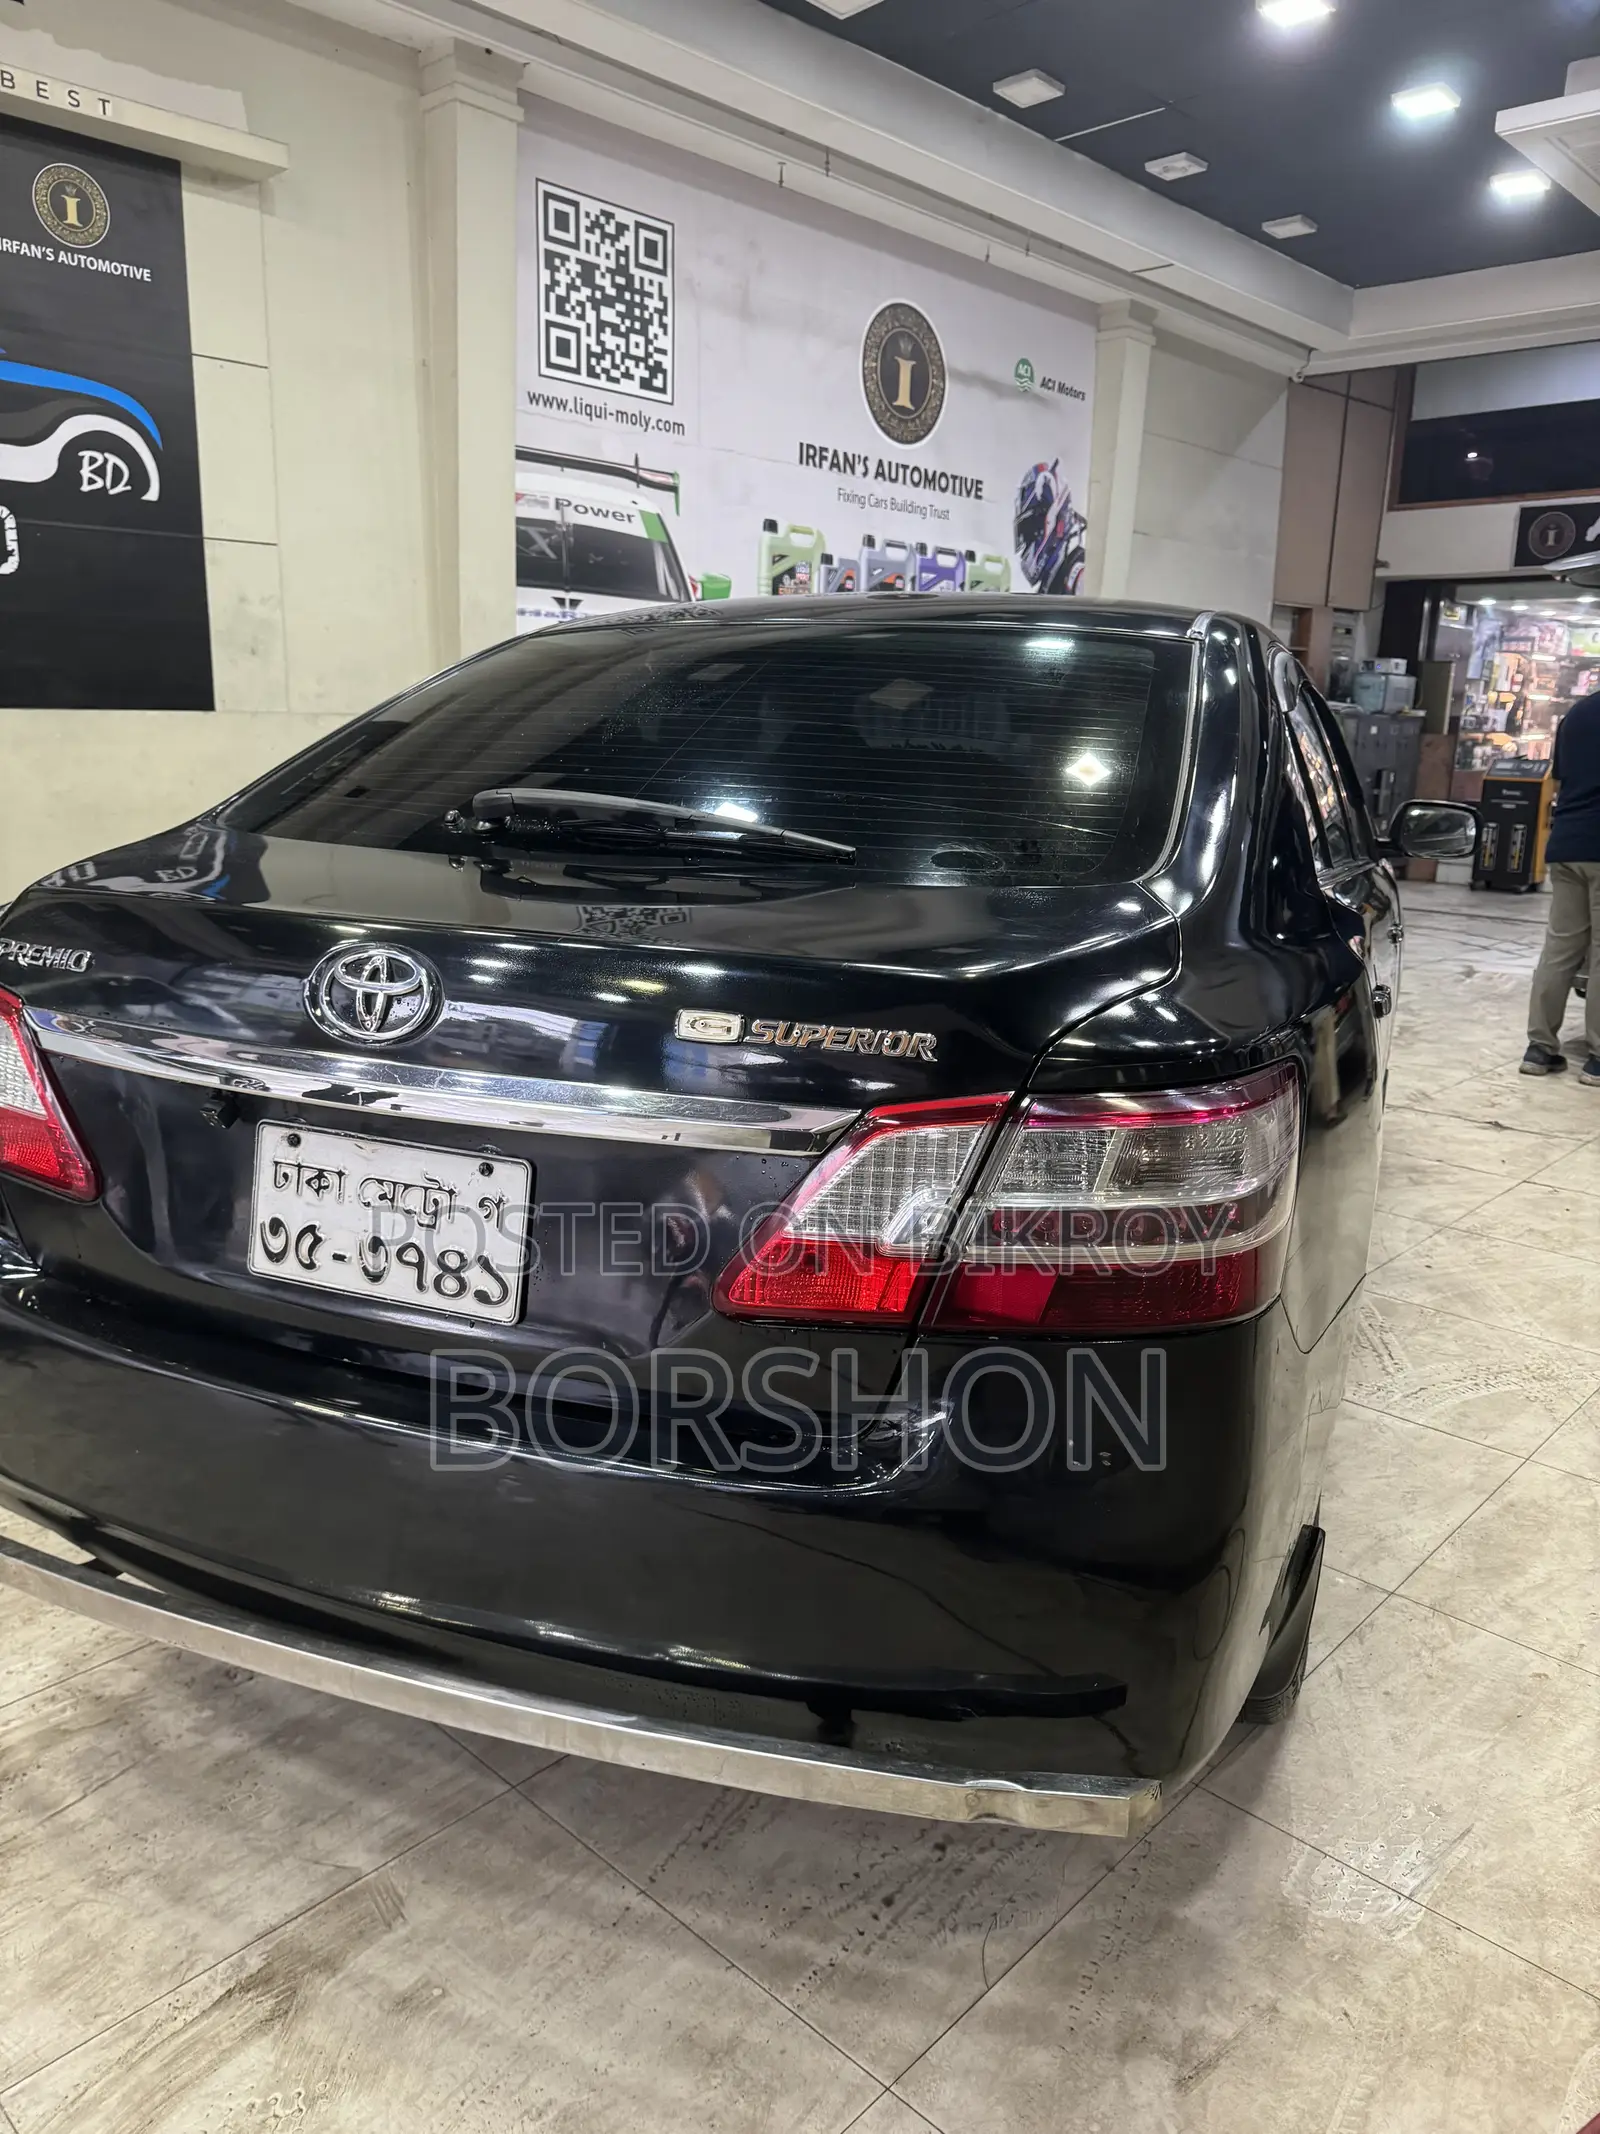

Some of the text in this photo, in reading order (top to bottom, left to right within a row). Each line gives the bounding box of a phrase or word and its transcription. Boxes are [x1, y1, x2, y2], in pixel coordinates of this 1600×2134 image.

[0, 69, 111, 116] BEST
[57, 250, 152, 282] AUTOMOTIVE
[1040, 376, 1086, 401] ACI Motors
[527, 390, 686, 436] www.liqui-moly.com
[78, 450, 132, 495] BD
[799, 441, 984, 500] IRFAN'S AUTOMOTIVE
[555, 497, 636, 523] Power
[837, 487, 950, 521] Fixing Cars Building Trust
[0, 937, 92, 972] PREMIO
[744, 1019, 938, 1062] SUPERIOR
[272, 1157, 347, 1204] ঢাকা
[478, 1193, 508, 1232] গ
